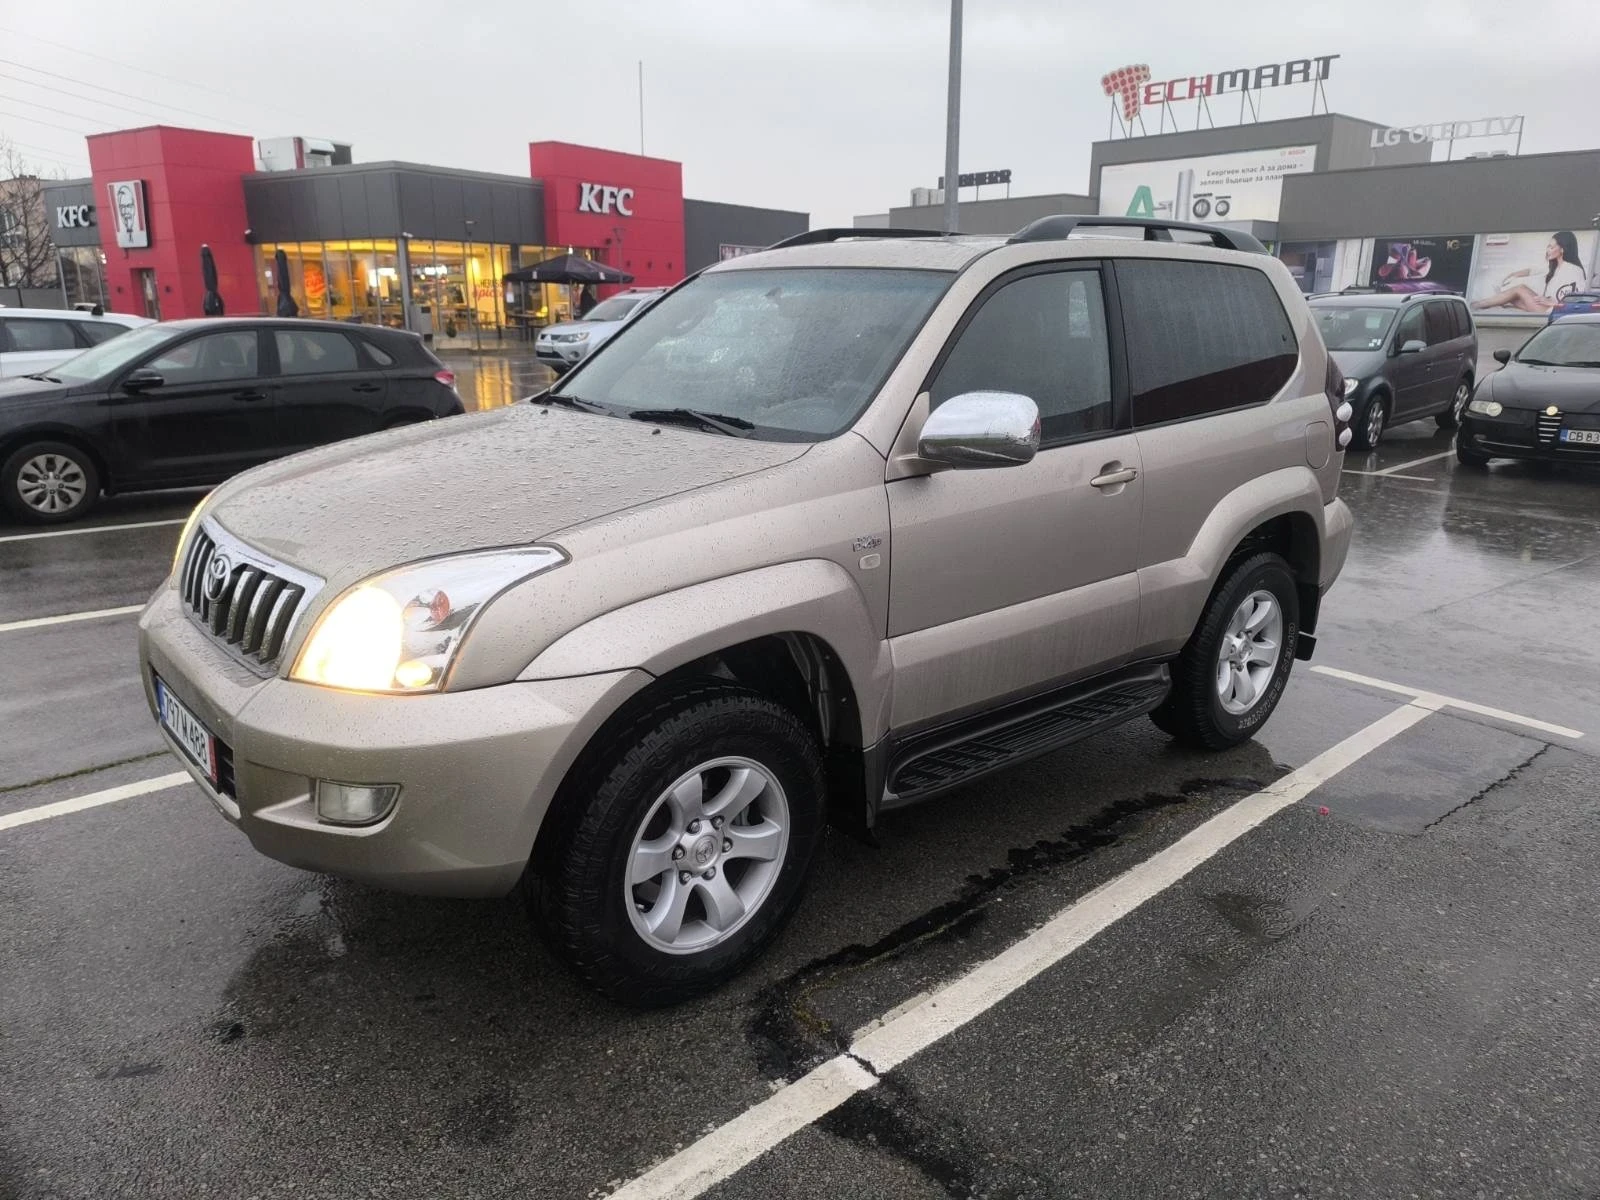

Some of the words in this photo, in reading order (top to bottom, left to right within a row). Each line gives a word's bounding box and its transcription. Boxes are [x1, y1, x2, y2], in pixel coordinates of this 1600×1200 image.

[1101, 54, 1341, 121] TECHMART
[1370, 127, 1400, 148] LG
[1408, 121, 1472, 143] OLED
[1482, 114, 1519, 135] TV
[56, 204, 90, 228] KFC
[579, 182, 634, 216] KFC
[1569, 431, 1583, 442] CB
